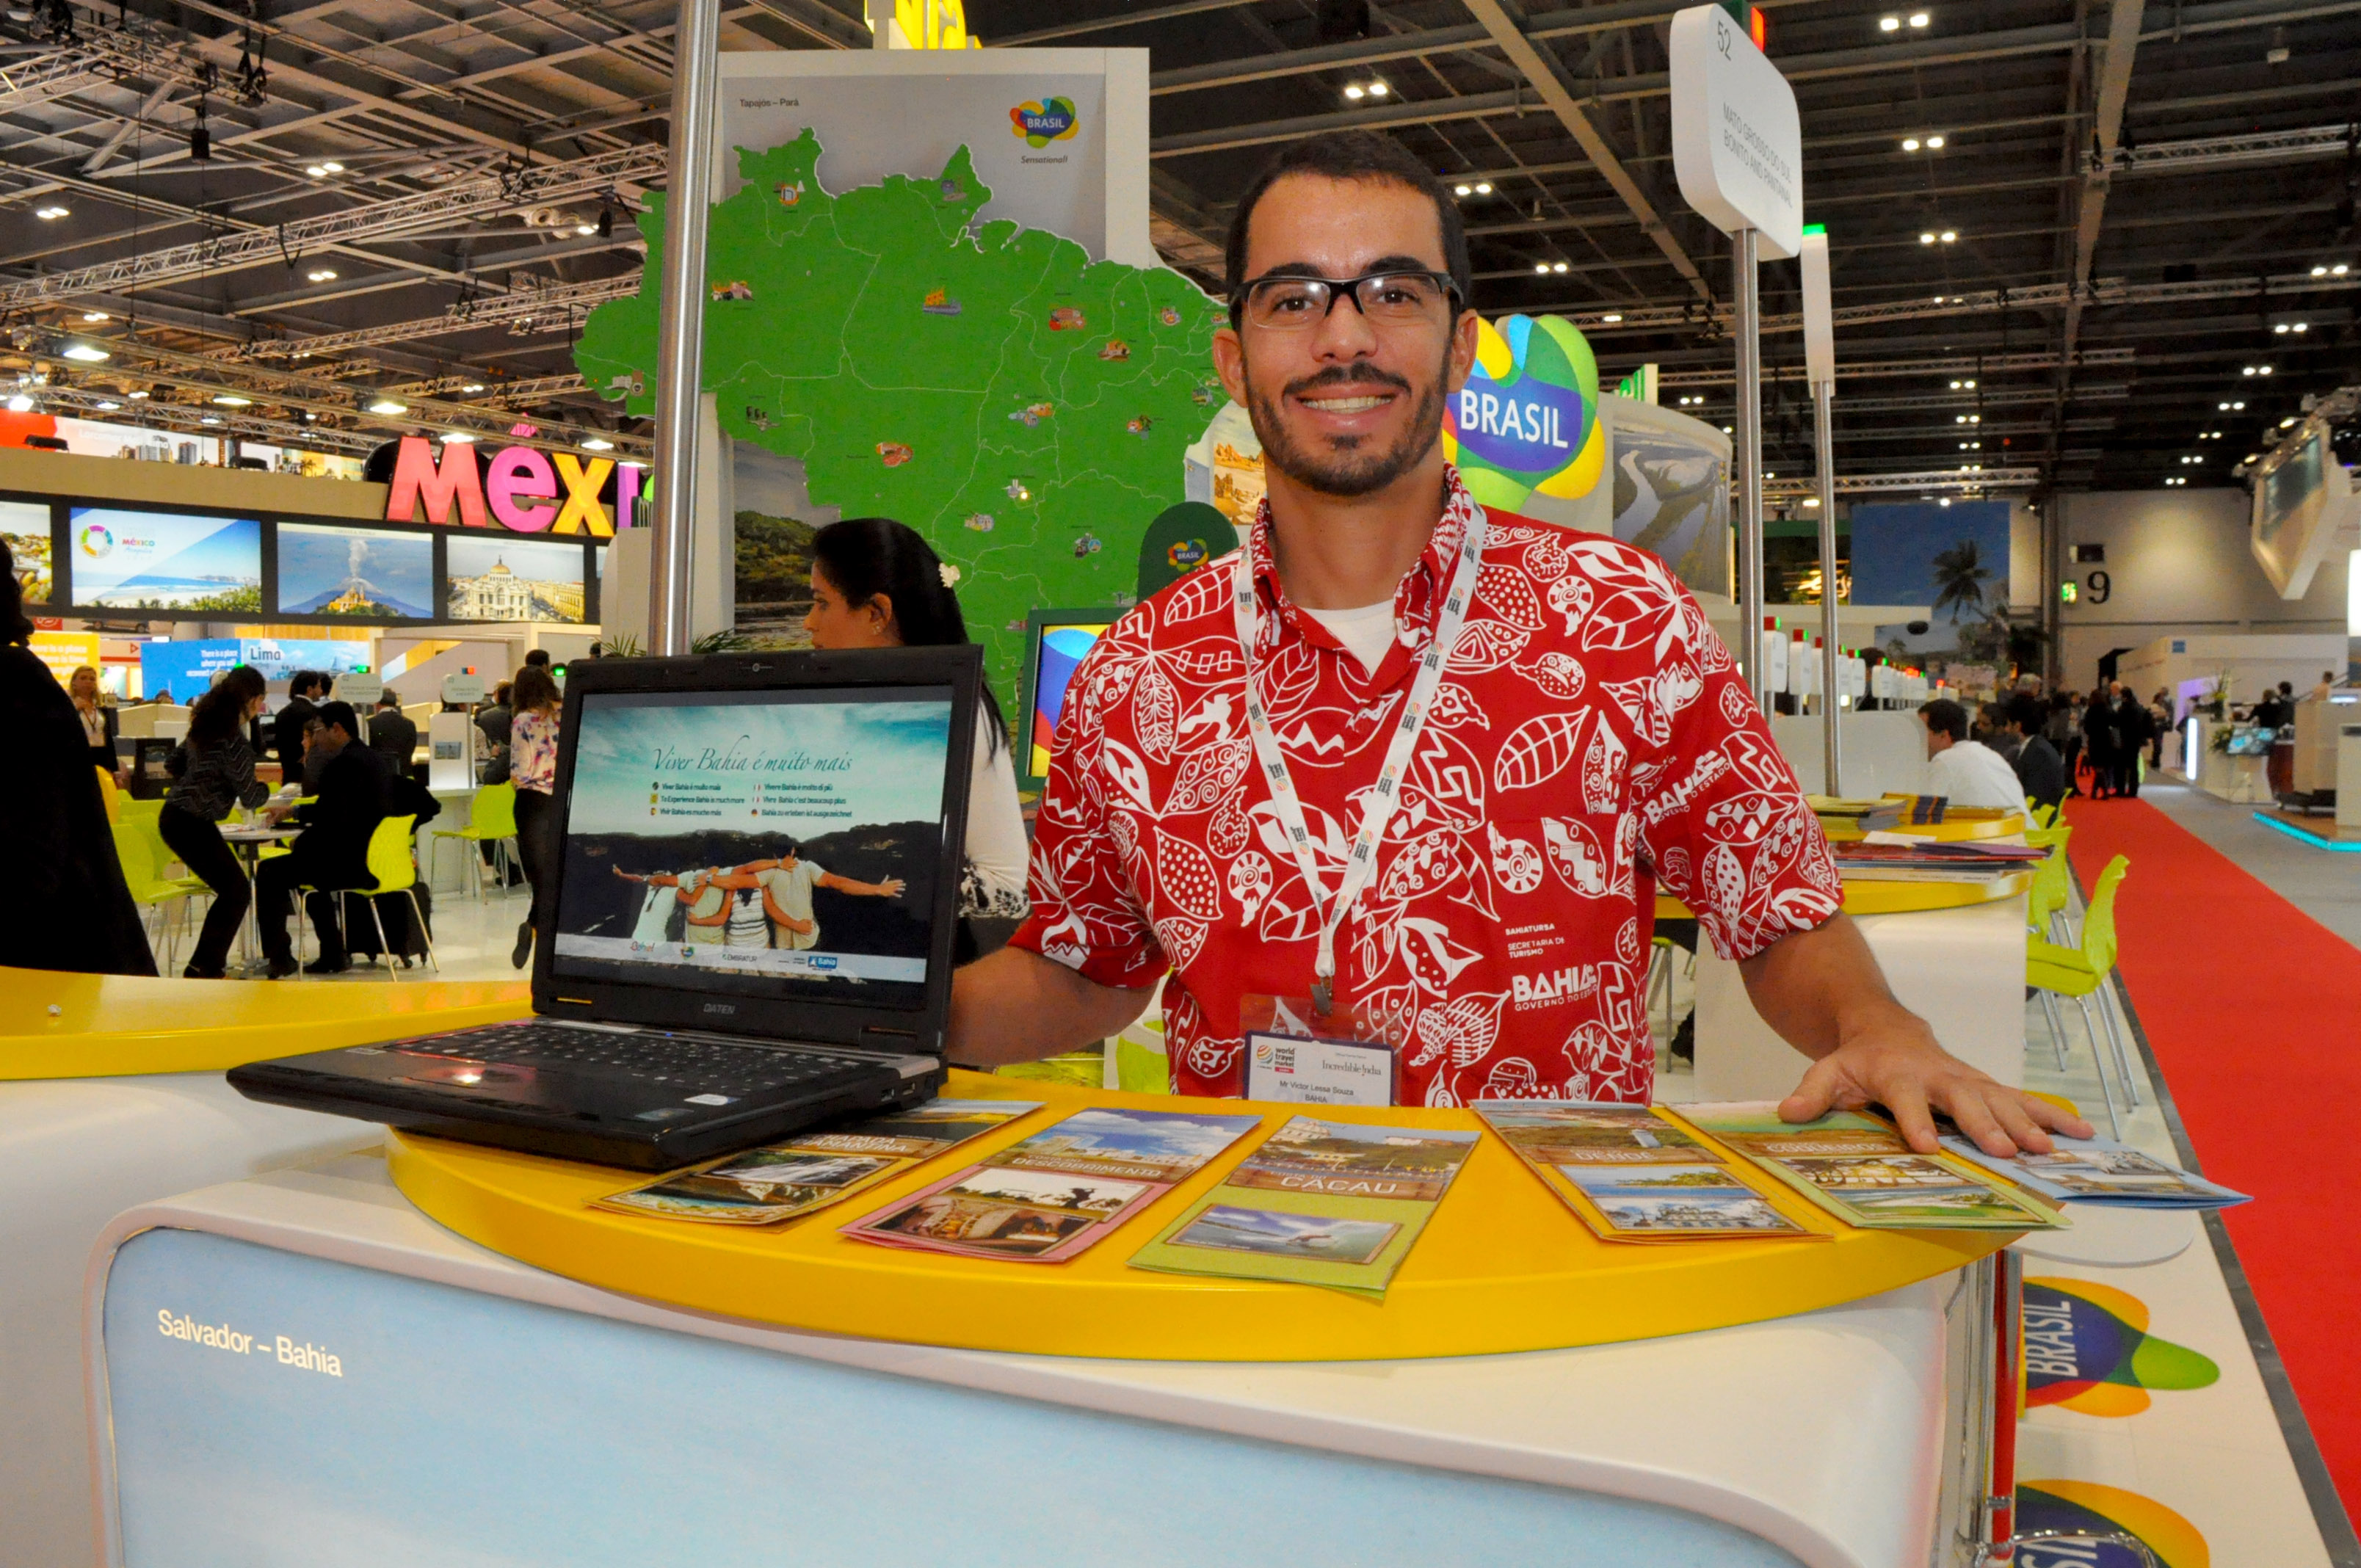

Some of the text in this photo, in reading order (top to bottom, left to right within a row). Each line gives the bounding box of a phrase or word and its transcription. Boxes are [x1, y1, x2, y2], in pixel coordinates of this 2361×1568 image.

[1717, 20, 1732, 62] 52
[739, 98, 772, 109] Tapajós
[780, 97, 799, 107] Pará
[1027, 117, 1065, 128] BRASIL
[1723, 101, 1742, 134] MATO
[1460, 388, 1569, 449] BRASIL
[1177, 551, 1200, 560] BRASIL
[2087, 570, 2111, 604] 9
[250, 647, 281, 661] Lima
[653, 734, 853, 772] Viver Bahia é muito mais
[1698, 761, 1731, 792] ESTADO
[1642, 762, 1715, 826] BAHA
[1505, 923, 1556, 936] BAHIATURSA
[1507, 937, 1554, 951] SECRETARIA
[1509, 948, 1544, 959] TURISMO
[818, 957, 836, 966] Bahia
[703, 1003, 736, 1014] DATEN
[1515, 996, 1565, 1012] GOVERNO
[1275, 1047, 1296, 1055] world
[1275, 1053, 1294, 1062] travel
[1290, 1081, 1310, 1090] Victor
[1310, 1084, 1330, 1093] Lessa
[1332, 1086, 1354, 1096] Souza
[1305, 1093, 1327, 1103] BAHIA
[1012, 1157, 1162, 1177] DESCOBRIMENTO
[1280, 1176, 1398, 1194] CACAU
[157, 1308, 253, 1355] Salvador
[275, 1335, 343, 1378] Bahia
[2023, 1300, 2079, 1377] BRASIL
